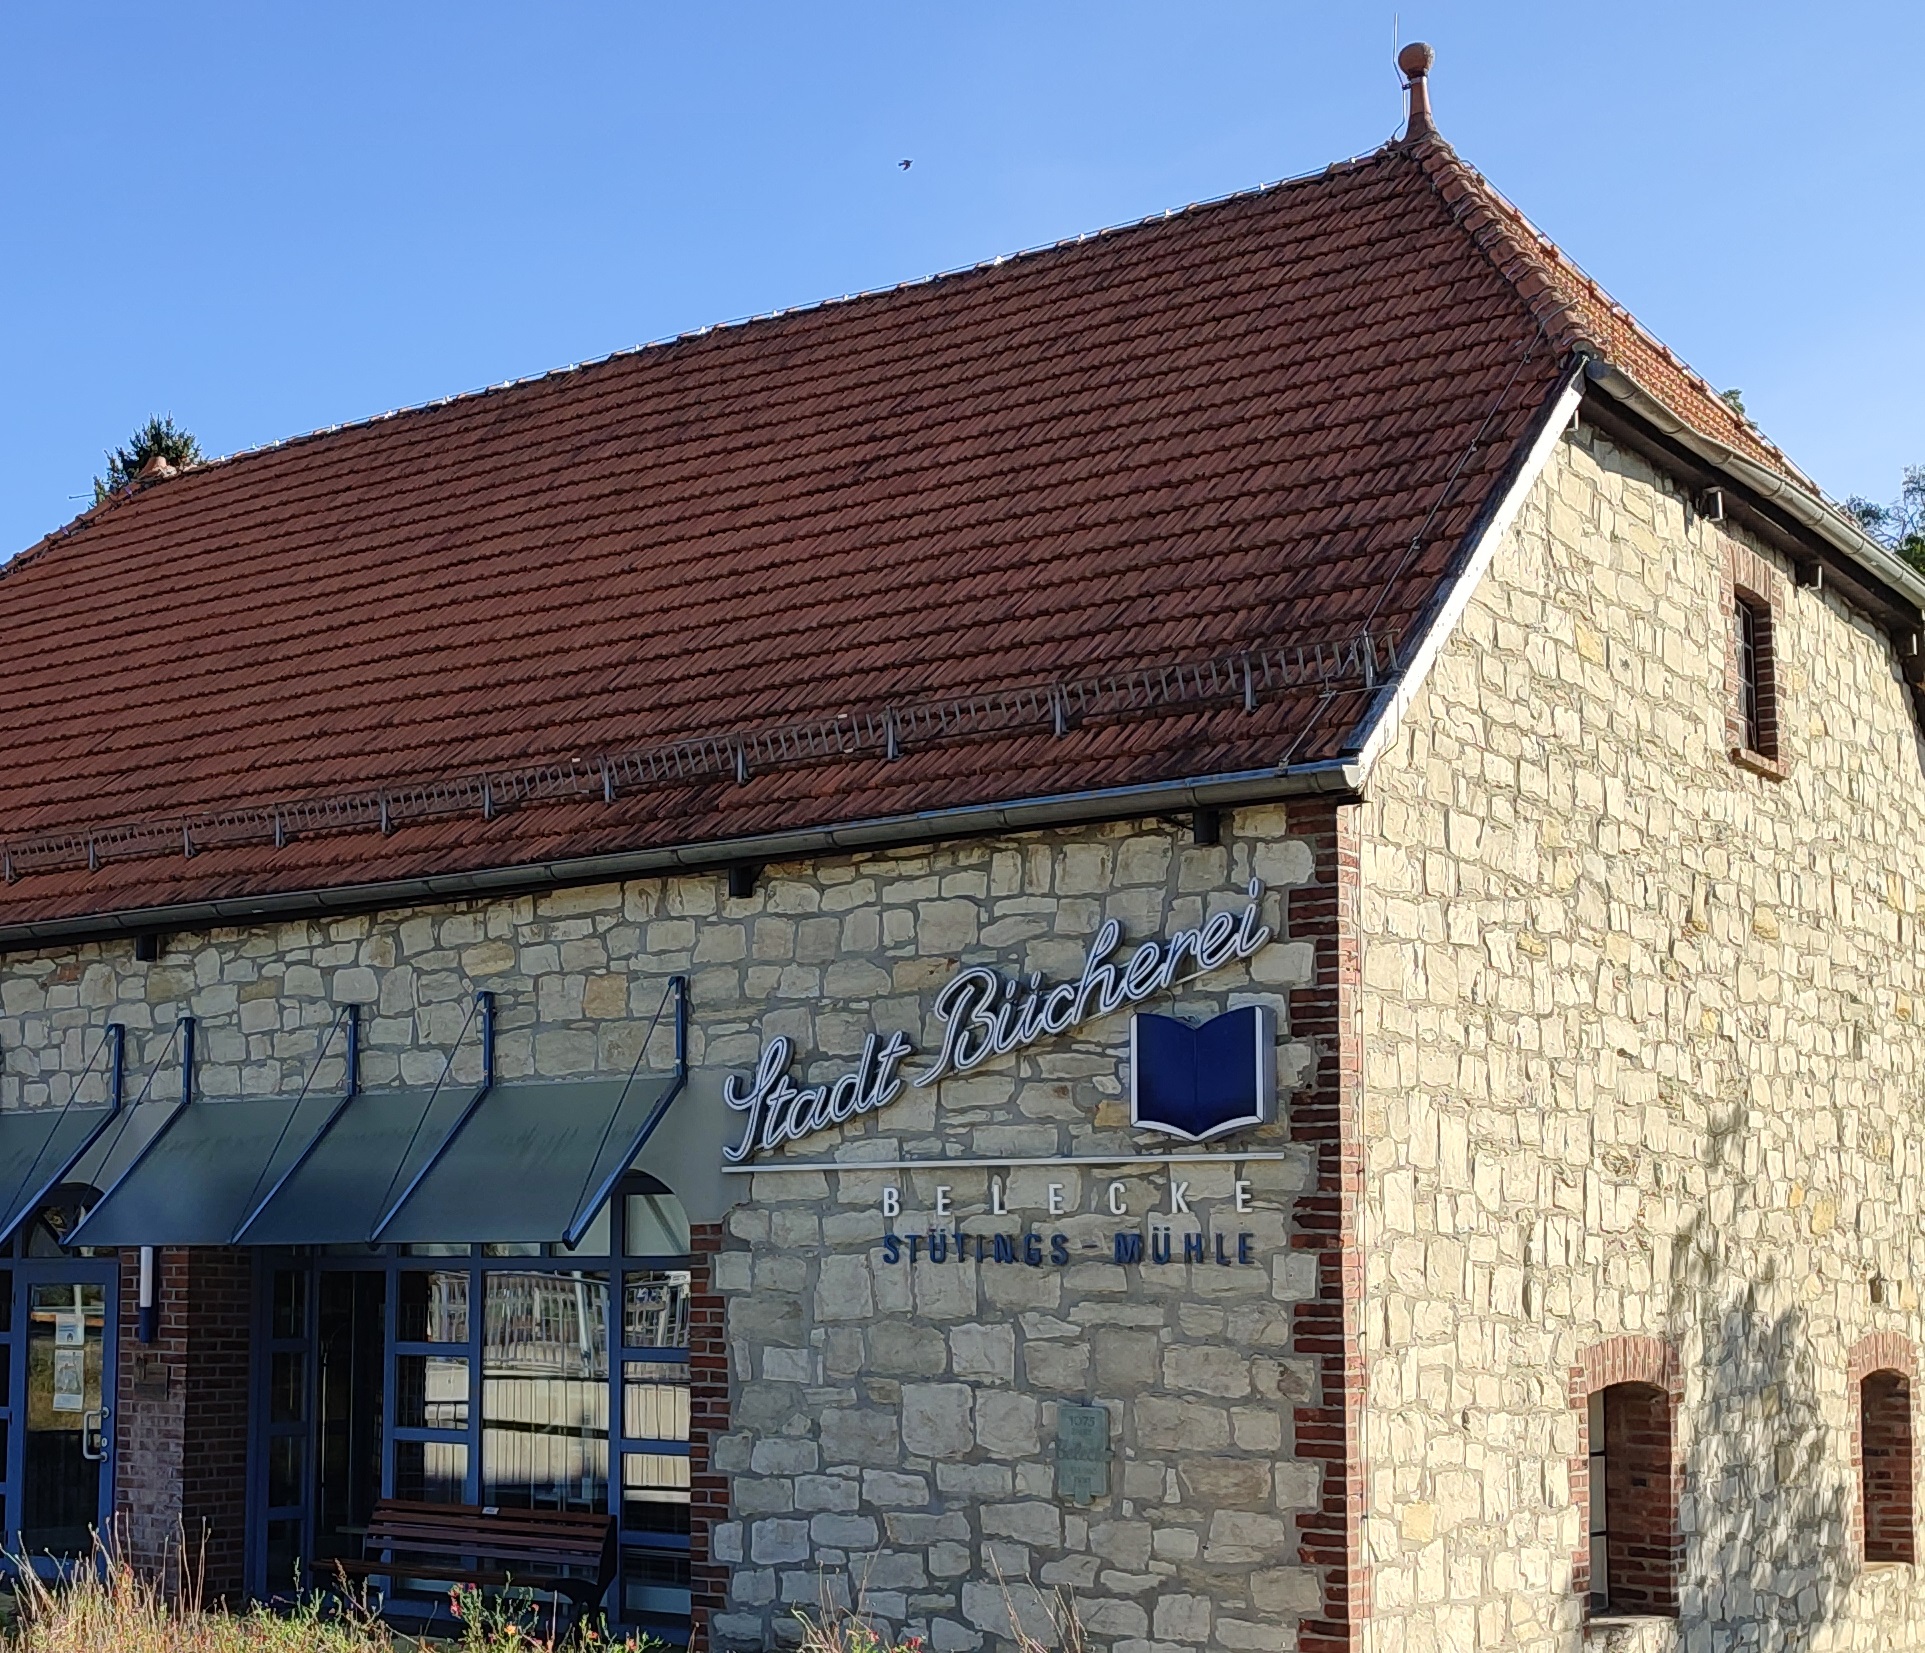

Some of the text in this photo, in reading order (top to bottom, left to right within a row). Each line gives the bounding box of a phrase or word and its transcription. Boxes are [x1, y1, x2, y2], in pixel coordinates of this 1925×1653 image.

[722, 876, 1270, 1162] Stadt Bücherei
[882, 1180, 1254, 1217] BELECKE
